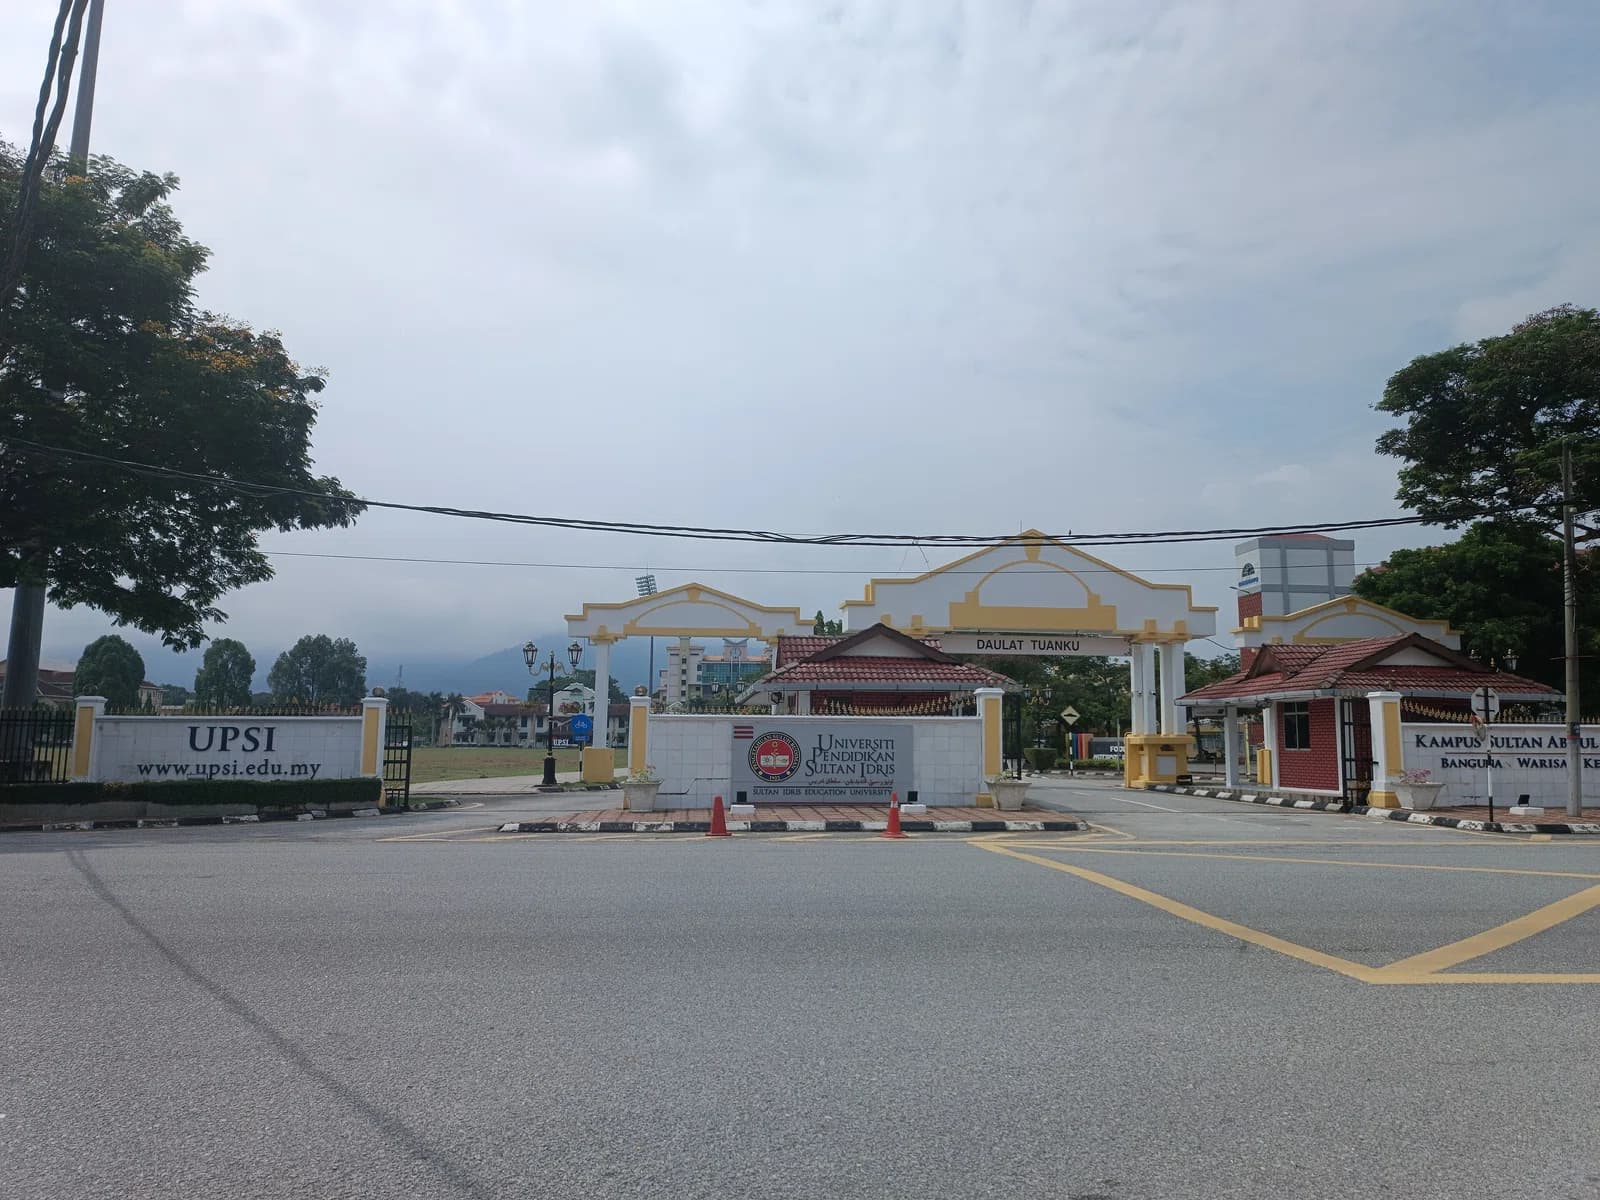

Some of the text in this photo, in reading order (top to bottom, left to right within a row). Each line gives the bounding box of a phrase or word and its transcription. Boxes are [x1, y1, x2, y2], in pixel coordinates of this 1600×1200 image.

[976, 639, 1080, 651] DAULAT TUANKU
[187, 726, 277, 752] UPSI
[817, 734, 894, 751] UNIVERSITI
[1415, 734, 1599, 749] KAMPUS SULTAN ABUL
[812, 747, 895, 763] PENDIDIKAN
[1517, 757, 1568, 769] WARISA
[137, 759, 321, 779] www.upsi.edu.my
[804, 759, 895, 777] SULTAN IDRIS
